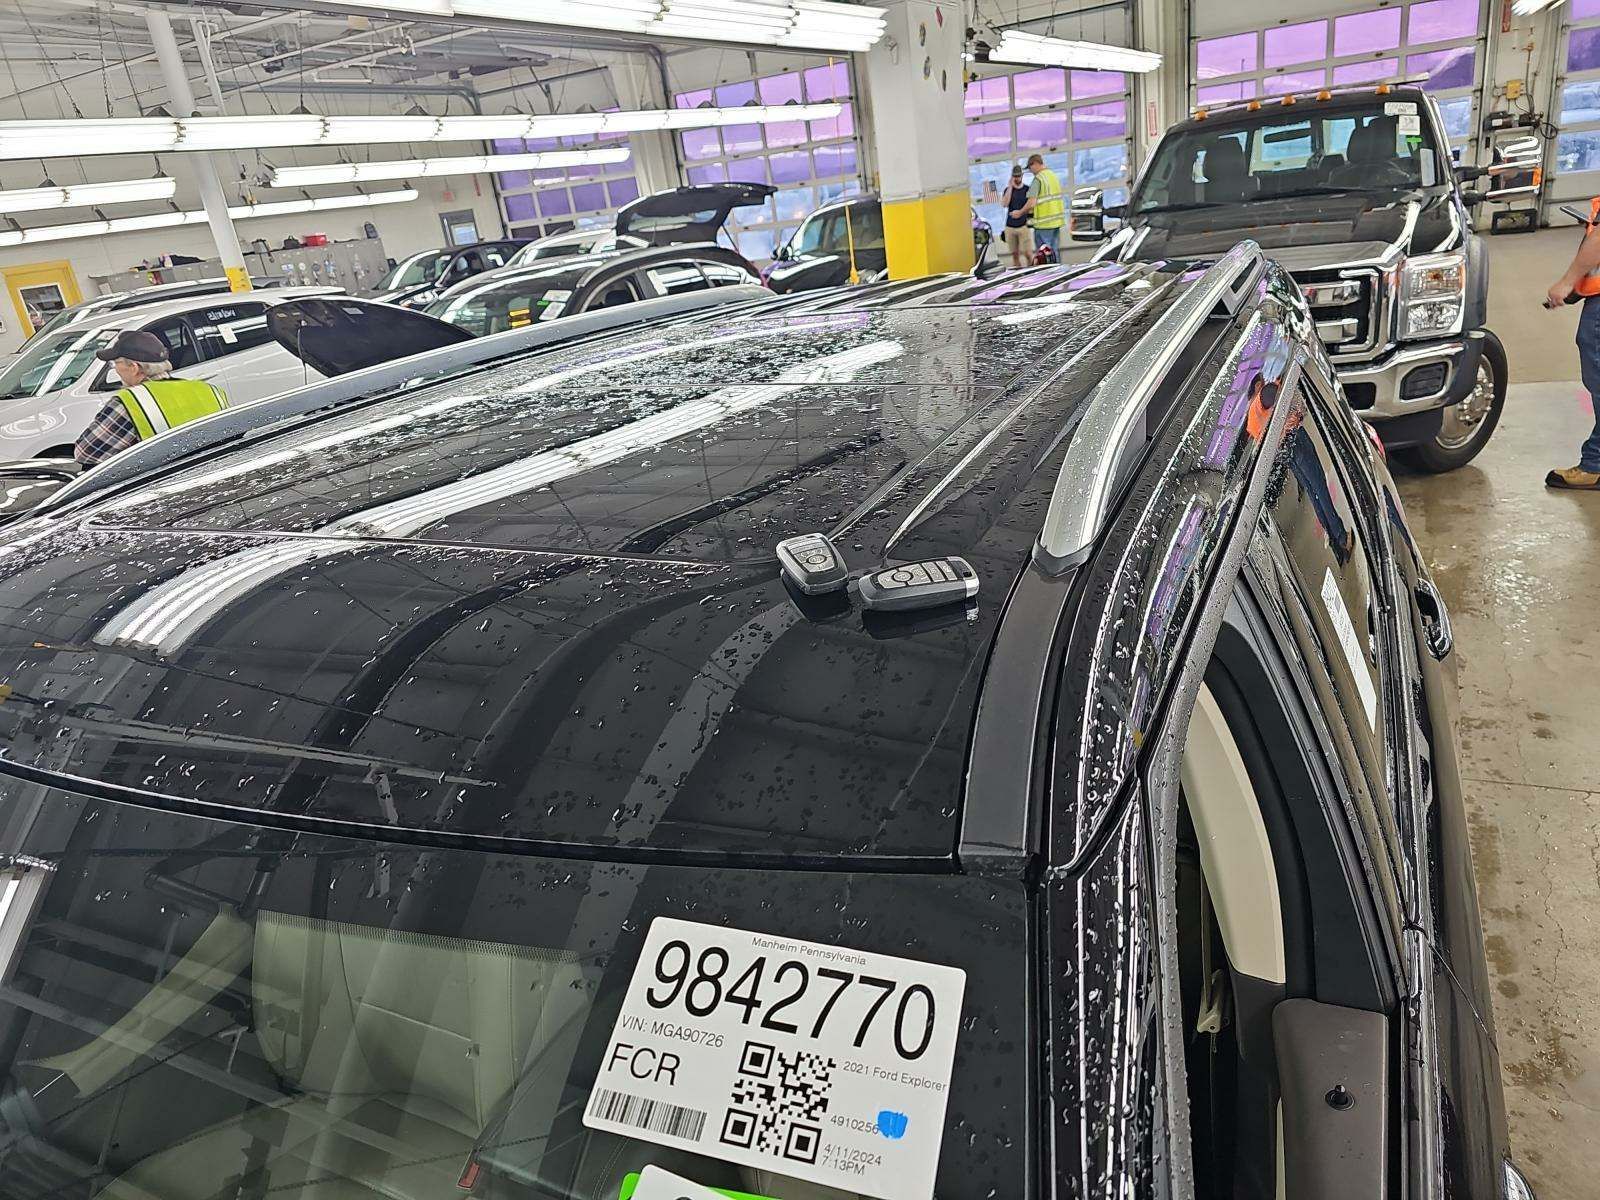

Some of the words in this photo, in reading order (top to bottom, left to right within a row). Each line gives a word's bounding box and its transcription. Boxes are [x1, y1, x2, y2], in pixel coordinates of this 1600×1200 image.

[751, 937, 798, 953] Manheim
[800, 945, 867, 966] Pennsylvania
[646, 939, 936, 1061] 9842770
[620, 1014, 648, 1033] VIN:
[650, 1021, 725, 1048] MGA90726
[607, 1042, 681, 1086] FCR
[843, 1061, 869, 1075] 2021
[872, 1066, 898, 1082] Ford
[900, 1072, 947, 1092] Explorer
[823, 1143, 882, 1166] 4/11/2024
